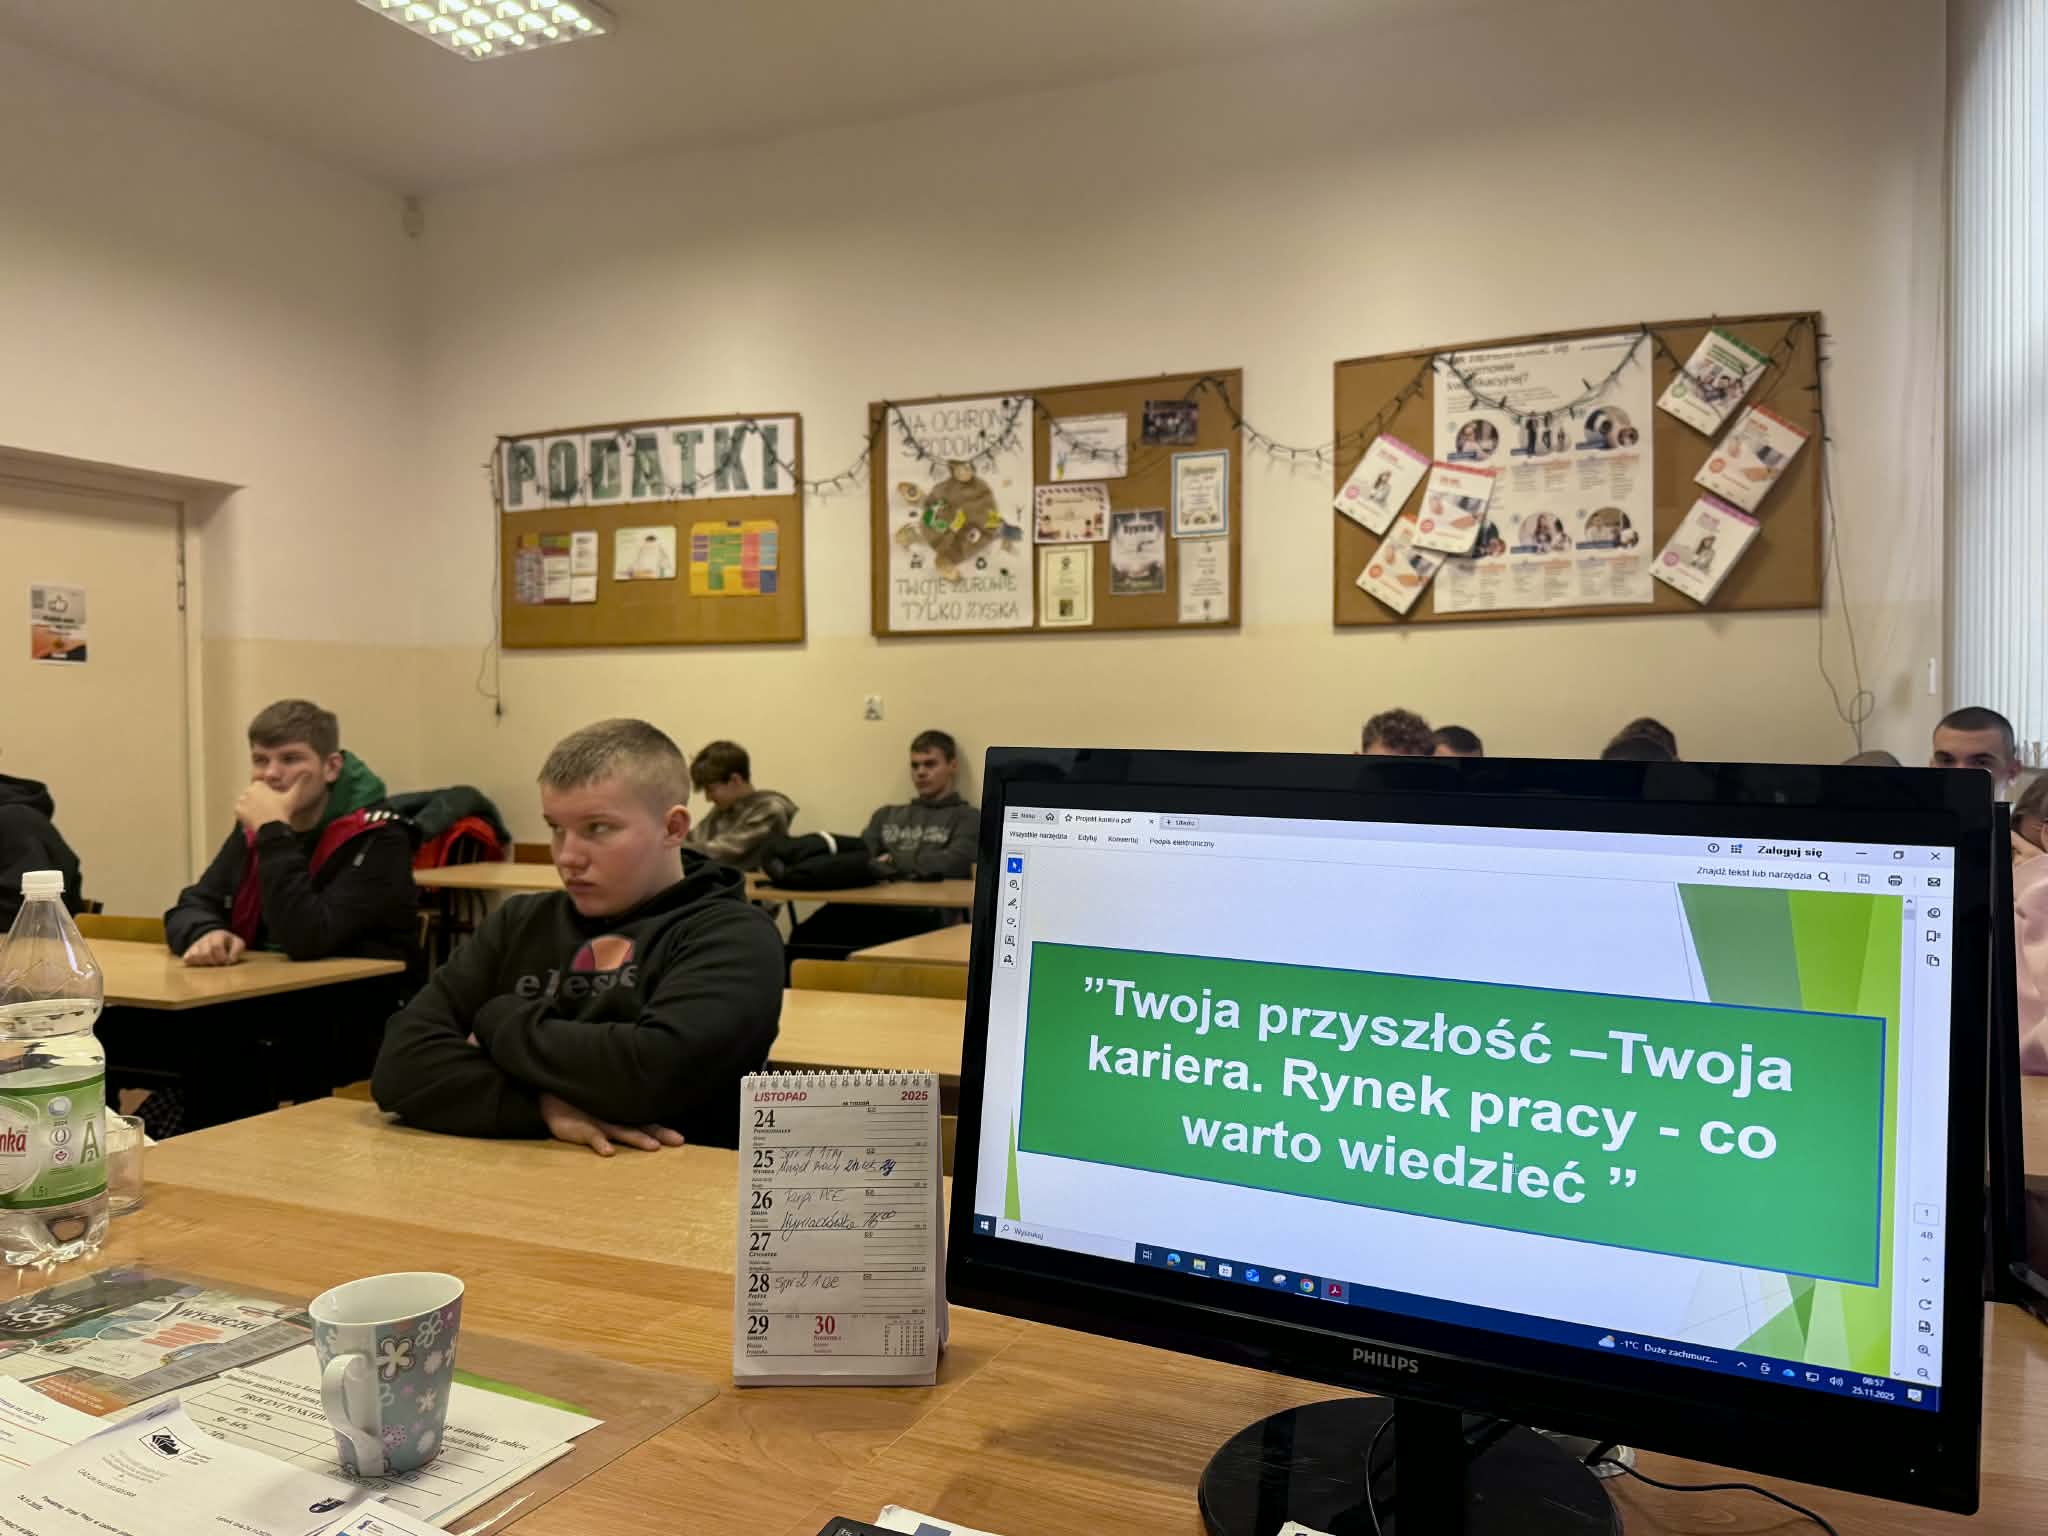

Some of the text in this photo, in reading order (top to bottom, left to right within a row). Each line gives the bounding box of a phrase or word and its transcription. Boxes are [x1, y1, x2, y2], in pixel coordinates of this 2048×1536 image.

[507, 424, 778, 506] PODATKI
[901, 600, 962, 621] TYLKO
[1757, 845, 1823, 859] Zaloguj się
[1728, 868, 1750, 878] tekst
[1752, 869, 1767, 878] lub
[1768, 870, 1812, 881] narzędzia
[1258, 1003, 1552, 1064] przyszłość
[754, 1090, 929, 1103] LISTOPAD 2025
[1088, 1034, 1263, 1093] kariera.
[1283, 1057, 1451, 1118] Rynek
[1470, 1090, 1637, 1152] pracy
[1700, 1119, 1777, 1159] co
[754, 1108, 776, 1128] 24
[753, 1149, 774, 1168] 25
[1182, 1115, 1321, 1164] warto
[1338, 1135, 1586, 1204] wiedzieć
[751, 1190, 773, 1210] 26
[749, 1231, 771, 1251] 27
[748, 1273, 770, 1293] 28
[177, 1307, 262, 1332] WYCIECZKI
[747, 1315, 836, 1335] 29 30
[1644, 1343, 1667, 1355] Duże
[1352, 1347, 1420, 1374] PHILIPS
[1851, 1385, 1896, 1401] 25.11.2025
